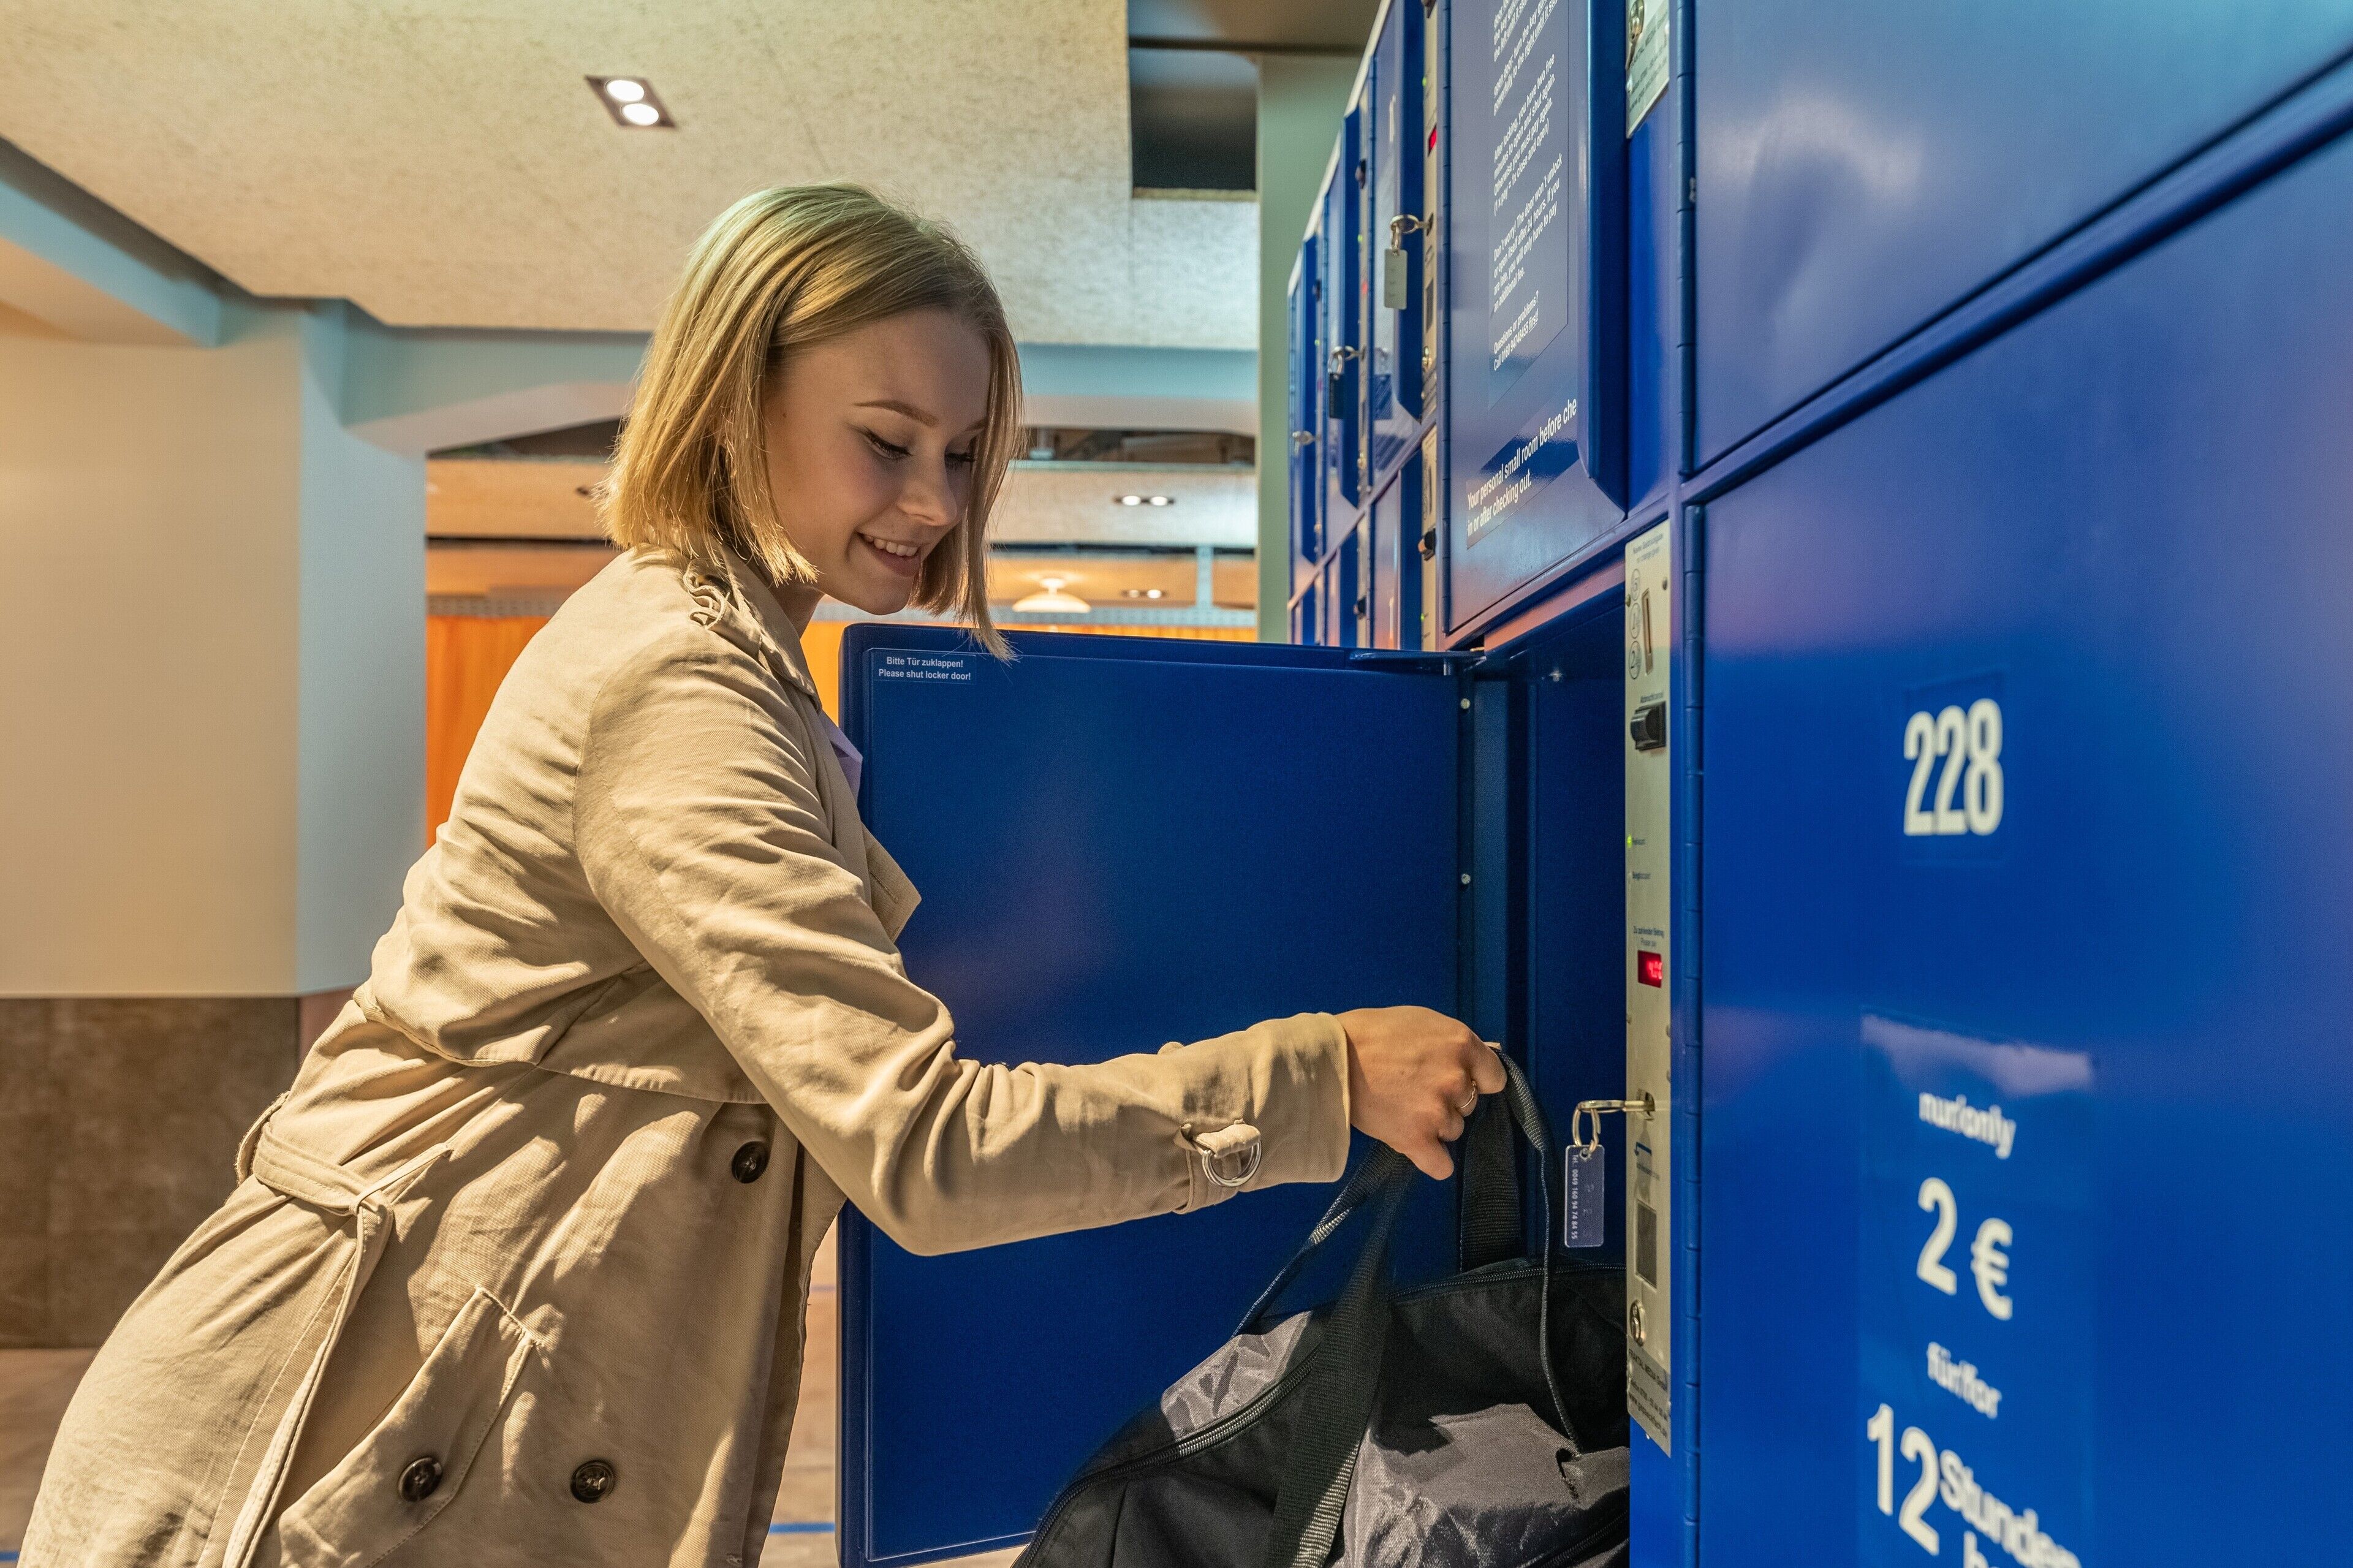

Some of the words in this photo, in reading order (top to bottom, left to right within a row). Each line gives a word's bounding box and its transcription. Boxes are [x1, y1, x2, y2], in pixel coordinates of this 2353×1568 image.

[1545, 5, 1548, 18] it
[1527, 85, 1536, 107] have
[1509, 143, 1513, 154] to
[1514, 127, 1523, 146] open
[1532, 93, 1541, 117] shut
[1517, 155, 1528, 177] close
[1537, 118, 1548, 146] open)
[1521, 131, 1530, 153] must
[1525, 197, 1534, 217] door
[1548, 151, 1562, 183] unlock
[1527, 216, 1532, 232] 24
[1533, 221, 1543, 242] have
[1544, 214, 1548, 227] to
[1513, 320, 1517, 331] or
[1468, 489, 1479, 510] Your
[1480, 464, 1503, 505] personal
[1504, 447, 1520, 479] small
[1521, 436, 1538, 463] room
[1540, 414, 1561, 446] before
[1468, 517, 1473, 536] in
[1473, 514, 1479, 531] or
[1480, 504, 1492, 526] after
[1493, 482, 1518, 515] checking
[1520, 468, 1531, 493] out.
[878, 668, 904, 678] Please
[906, 670, 923, 678] shut
[925, 670, 949, 680] locker
[951, 672, 971, 680] door!
[886, 656, 904, 665] Bitte
[907, 657, 920, 666] Tür
[922, 659, 963, 668] zuklappen!
[1903, 698, 2004, 836] 228
[1572, 1201, 1578, 1210] 94
[1572, 1231, 1578, 1240] 55
[1916, 1176, 1958, 1297] 2
[1969, 1217, 2014, 1321] €
[1866, 1403, 1940, 1556] 12
